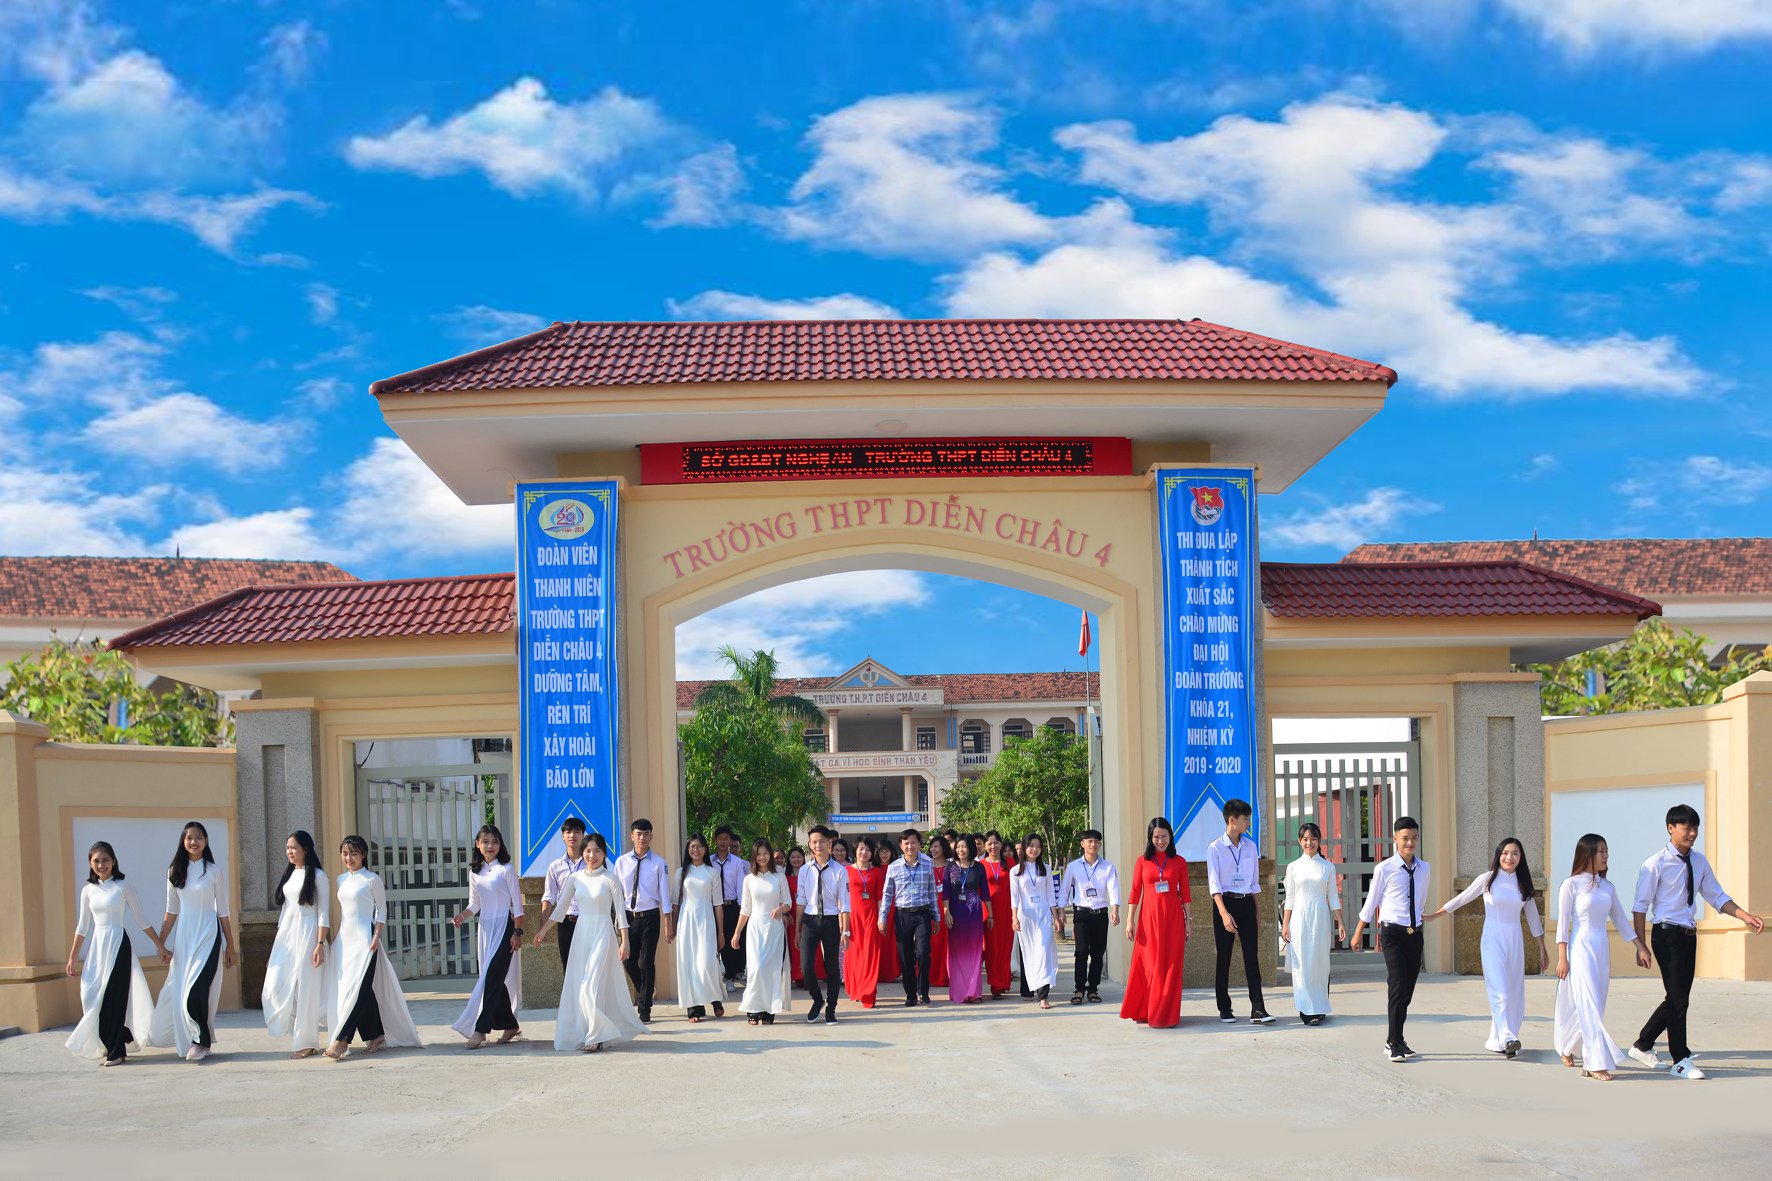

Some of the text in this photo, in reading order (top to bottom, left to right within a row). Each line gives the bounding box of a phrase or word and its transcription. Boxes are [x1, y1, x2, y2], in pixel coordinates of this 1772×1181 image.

[831, 452, 852, 464] AN
[937, 450, 977, 462] THPT
[1064, 450, 1073, 461] 4
[663, 495, 1113, 579] TRƯỜNG THPT DIỄN CHÂU 4
[1176, 528, 1238, 553] THI ĐUA LẬP
[537, 542, 598, 566] ĐOÀN VIÊN
[1180, 556, 1238, 577] THÀNH TÍCH
[534, 574, 602, 598] THANH NIÊN
[1186, 582, 1234, 606] XUẤT SẮC
[530, 605, 605, 629] TRƯỜNG THPT
[1179, 611, 1239, 634] CHÀO MỪNG
[533, 634, 603, 661] DIỄN CHÂU 4
[1193, 641, 1229, 665] ĐẠI HỘI
[534, 668, 603, 694] DƯỠNG TÂM,
[1175, 667, 1244, 690] ĐOÀN TRƯỜNG
[921, 692, 928, 702] 4
[1190, 697, 1234, 719] KHÓA 21,
[547, 701, 591, 725] RÈN TRÍ
[544, 732, 596, 756] XÂY HOÀI
[1187, 724, 1235, 749] NHIỆM KỲ
[545, 763, 595, 788] BÃO LỚN
[1184, 756, 1207, 774] 2019
[1215, 756, 1241, 774] 2020
